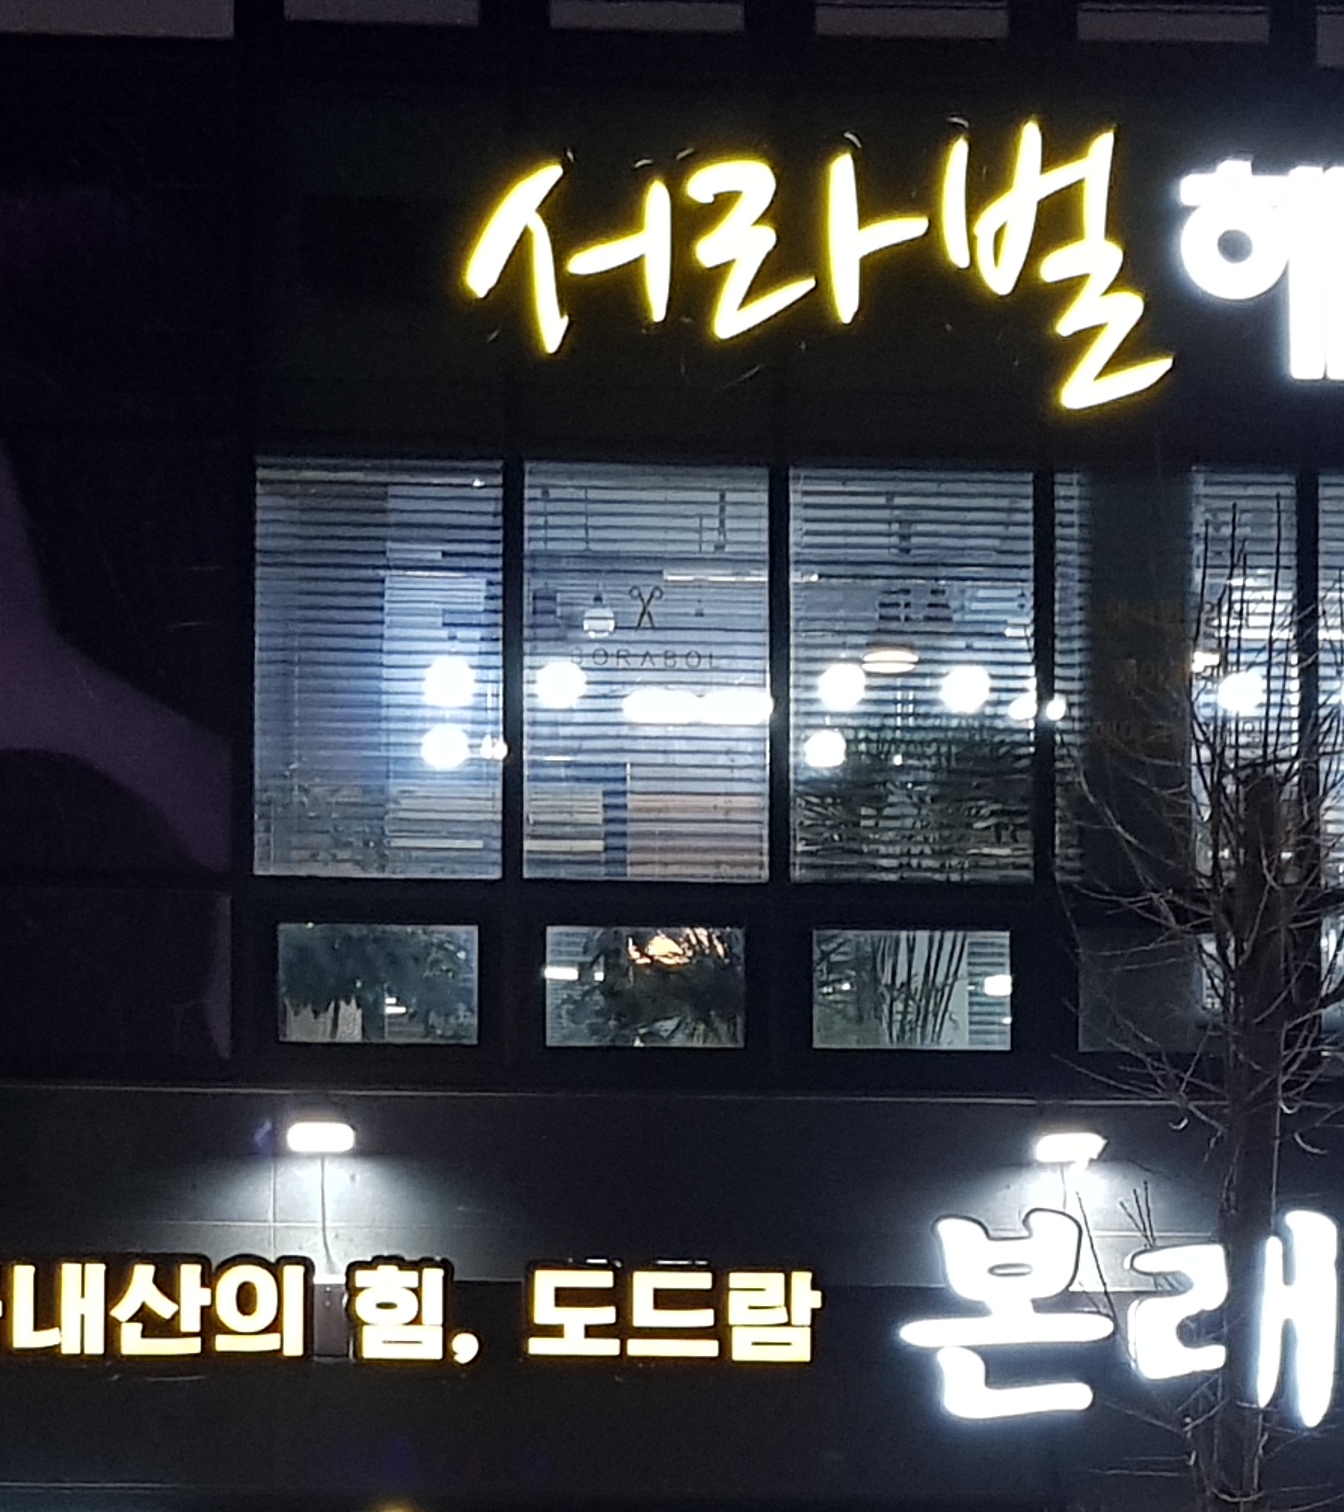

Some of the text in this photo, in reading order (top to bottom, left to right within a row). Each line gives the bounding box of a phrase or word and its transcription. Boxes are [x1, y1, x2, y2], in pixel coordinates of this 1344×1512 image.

[460, 113, 1176, 412] 서라벌
[570, 647, 721, 669] SORABOL
[351, 1263, 481, 1367] 힘,
[524, 1268, 826, 1364] 도드람
